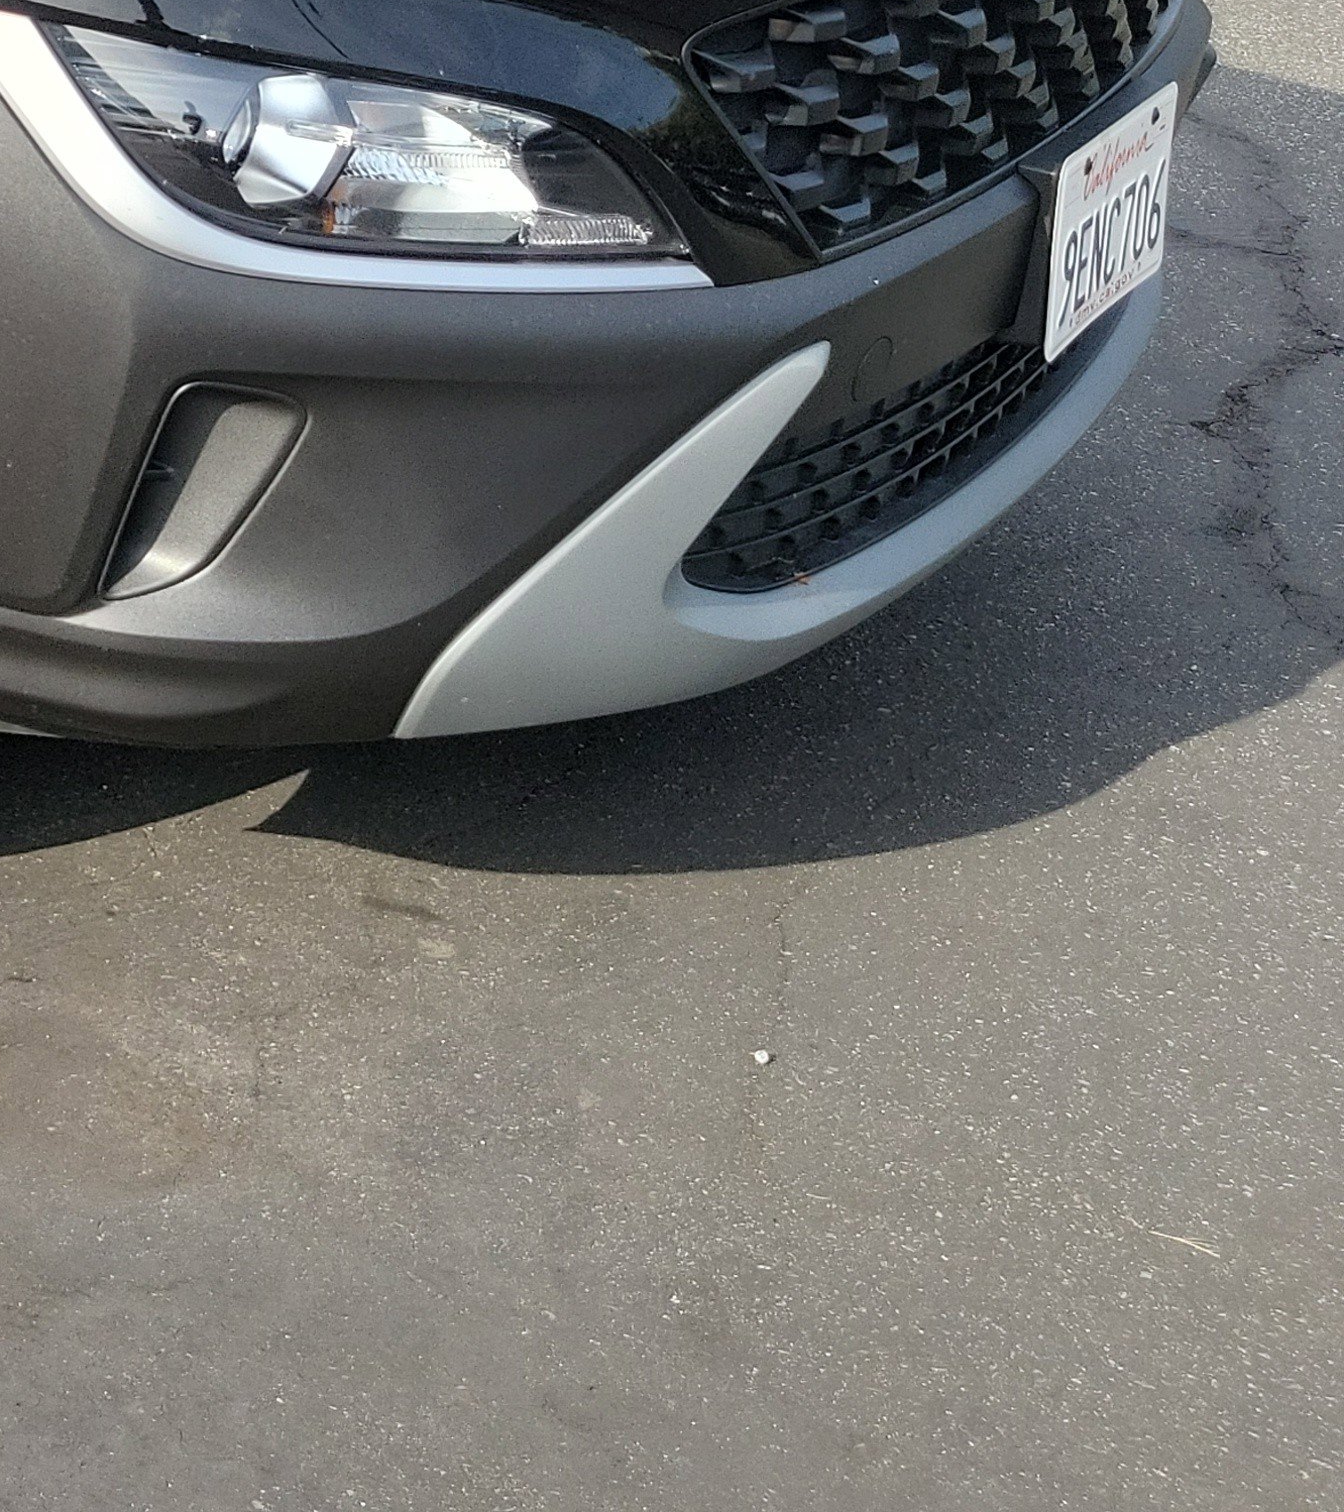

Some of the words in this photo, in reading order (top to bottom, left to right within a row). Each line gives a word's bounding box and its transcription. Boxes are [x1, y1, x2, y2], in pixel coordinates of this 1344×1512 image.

[1083, 130, 1154, 201] California
[1056, 158, 1166, 329] 9ENC706
[1074, 268, 1136, 326] dmv.ca.gov
